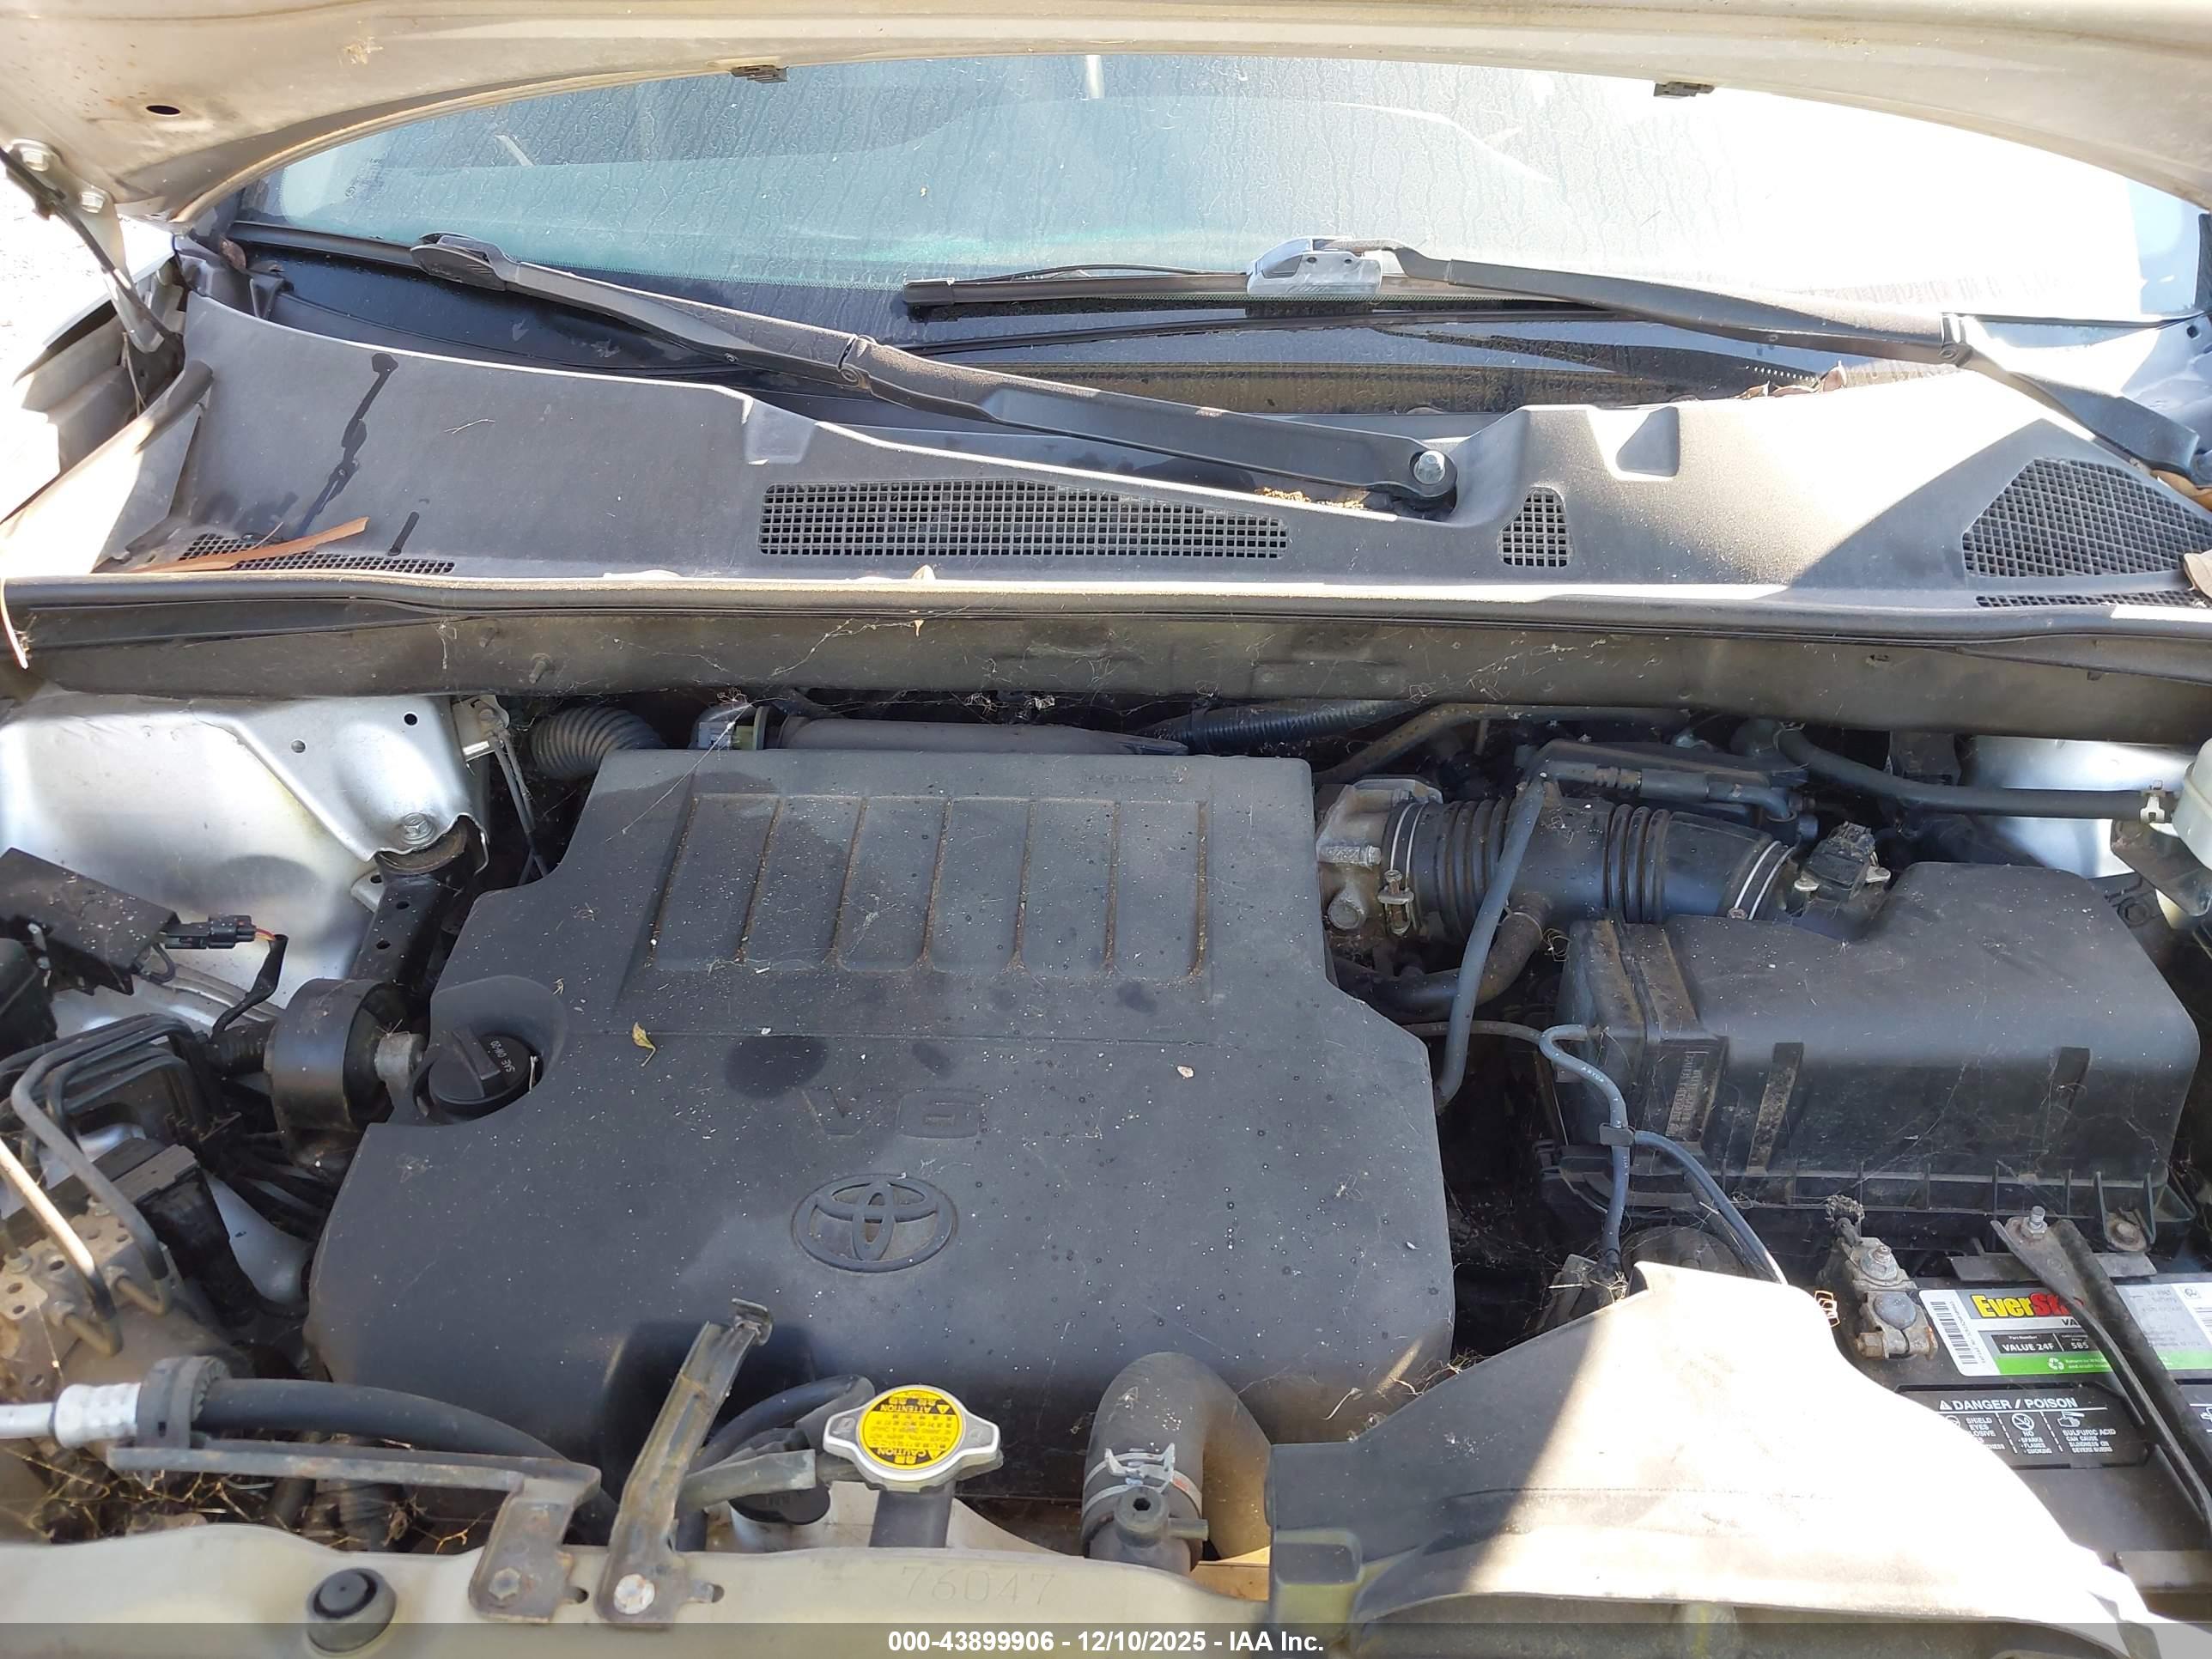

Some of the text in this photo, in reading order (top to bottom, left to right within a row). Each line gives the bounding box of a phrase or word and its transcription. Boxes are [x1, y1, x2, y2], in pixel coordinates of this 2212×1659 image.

[490, 1040, 515, 1073] SAE 0W-20
[2002, 1342, 2055, 1352] VALUE 24F
[879, 1403, 932, 1413] ATTENTION
[1951, 1398, 2078, 1410] DANGER / POISON
[877, 1448, 927, 1457] CAUTION
[901, 1566, 1056, 1605] 76047
